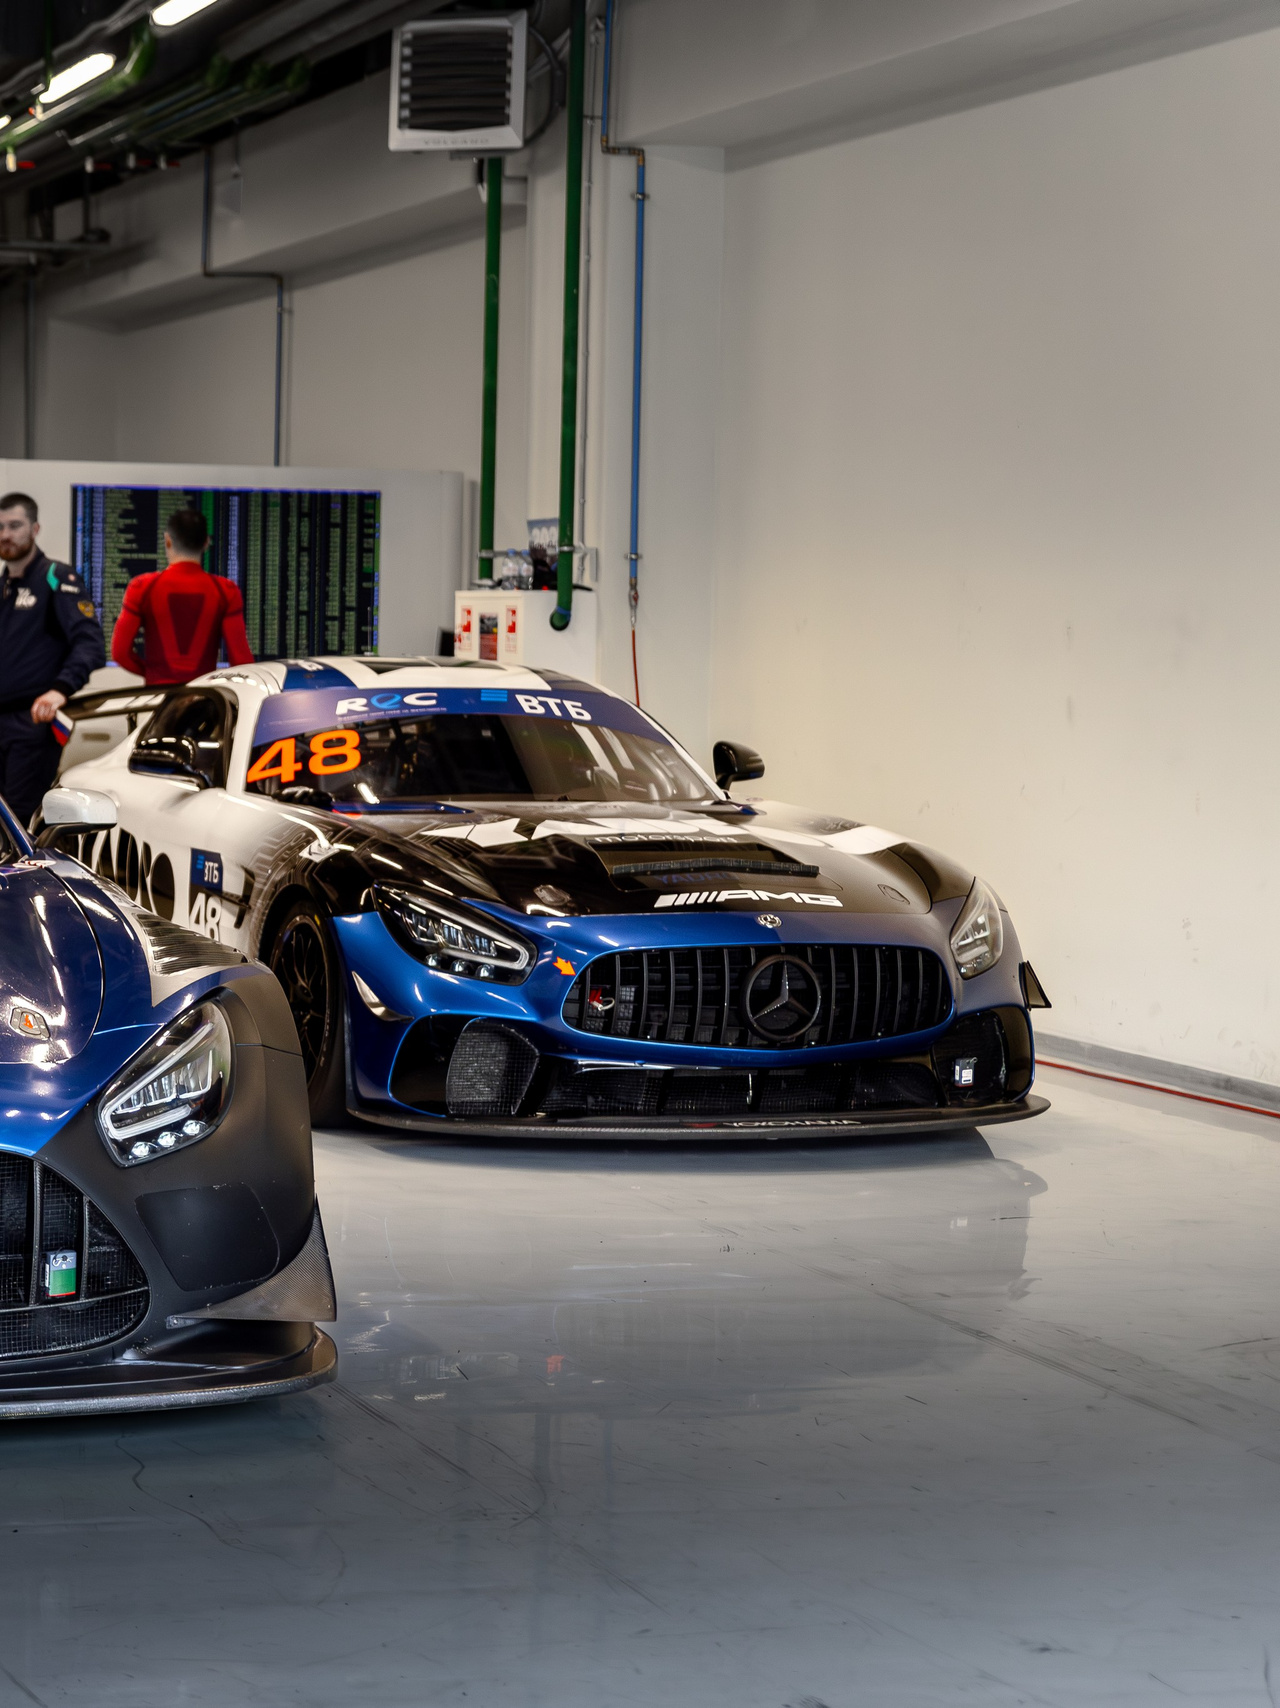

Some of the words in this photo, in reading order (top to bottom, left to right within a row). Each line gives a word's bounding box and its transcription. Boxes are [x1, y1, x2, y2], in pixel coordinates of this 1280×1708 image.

[515, 694, 592, 721] ВТБ
[247, 729, 361, 784] 48
[190, 892, 222, 941] 48
[716, 890, 844, 907] AMG
